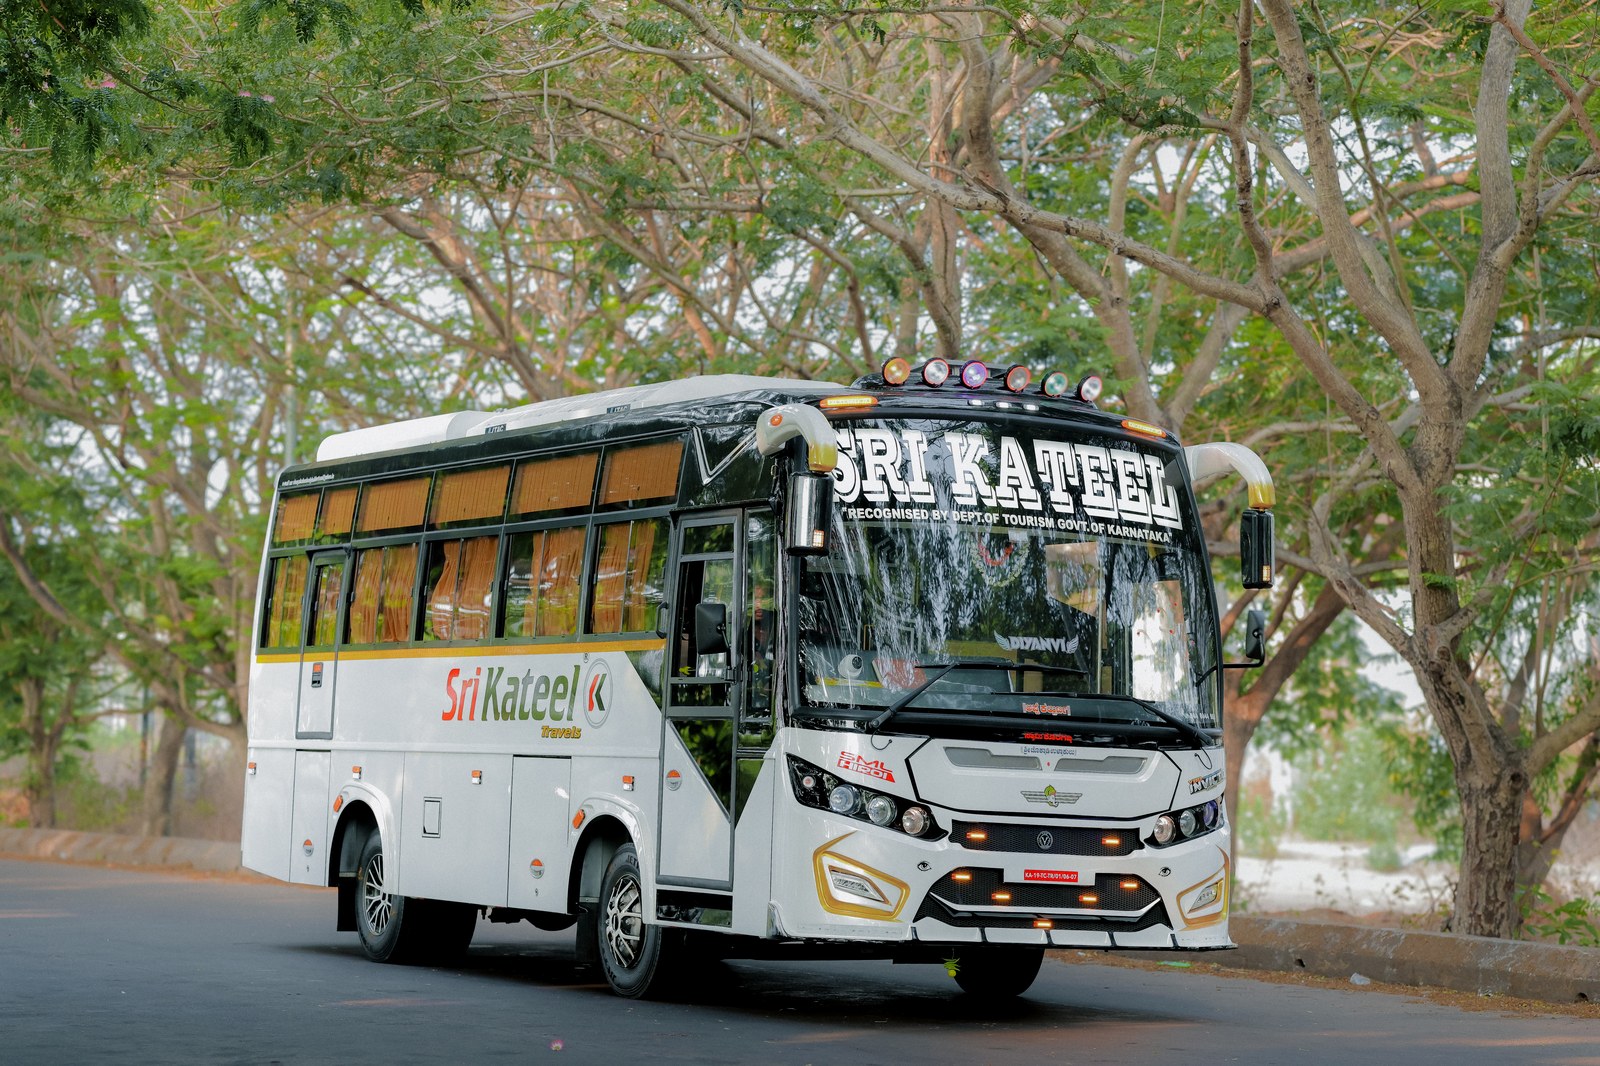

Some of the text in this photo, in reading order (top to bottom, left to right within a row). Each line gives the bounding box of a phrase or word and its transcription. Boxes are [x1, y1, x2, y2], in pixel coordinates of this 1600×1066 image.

[833, 428, 1183, 530] SRI KATEEL
[842, 507, 929, 520] "RECOGNISED
[932, 510, 948, 520] BY
[1002, 513, 1055, 529] TOURISM
[1108, 525, 1173, 543] KARNATAKA"
[442, 664, 581, 722] Sri Kateel
[541, 725, 582, 739] Travels
[840, 751, 893, 773] SML
